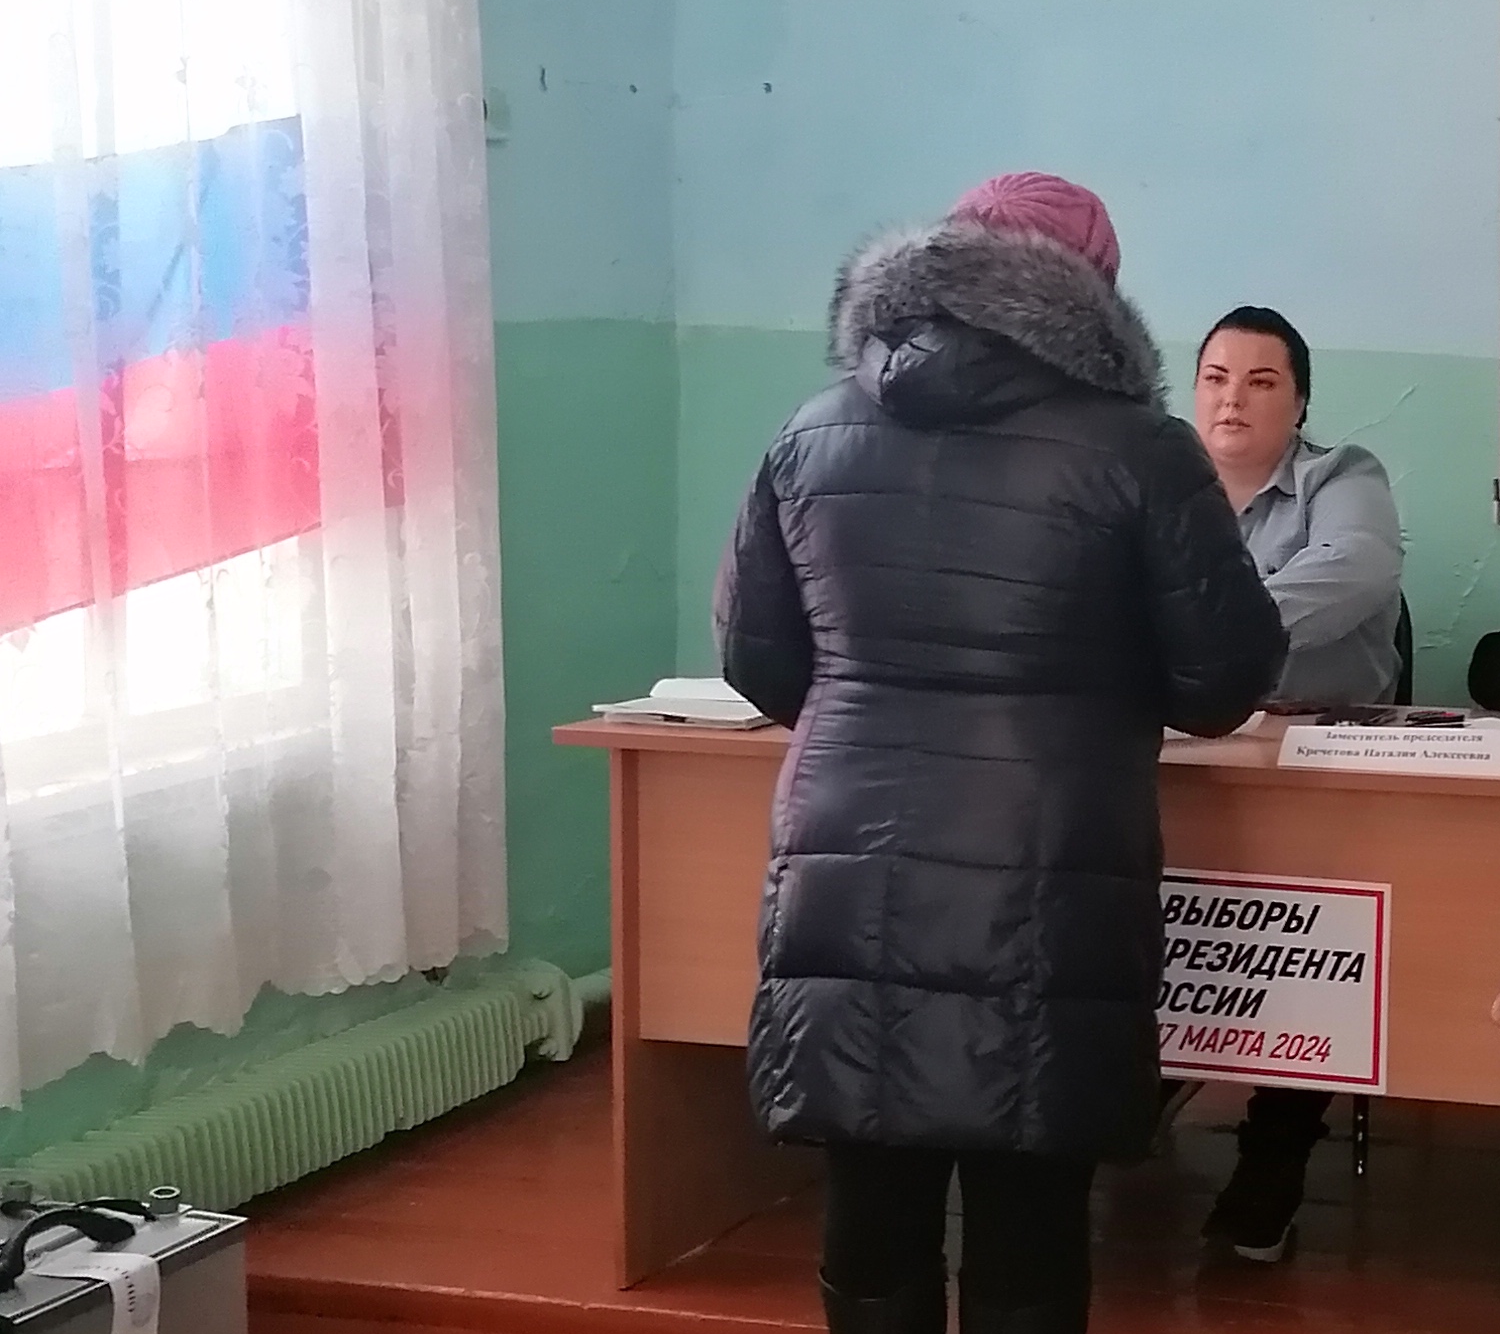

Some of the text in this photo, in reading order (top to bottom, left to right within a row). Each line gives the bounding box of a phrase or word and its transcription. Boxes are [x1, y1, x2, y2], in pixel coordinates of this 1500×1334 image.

[1163, 894, 1321, 935] ВЫБОРЫ
[1164, 937, 1366, 983] РЕЗИДЕНТА
[1178, 1025, 1266, 1057] МАРТА
[1268, 1032, 1333, 1063] 2024
